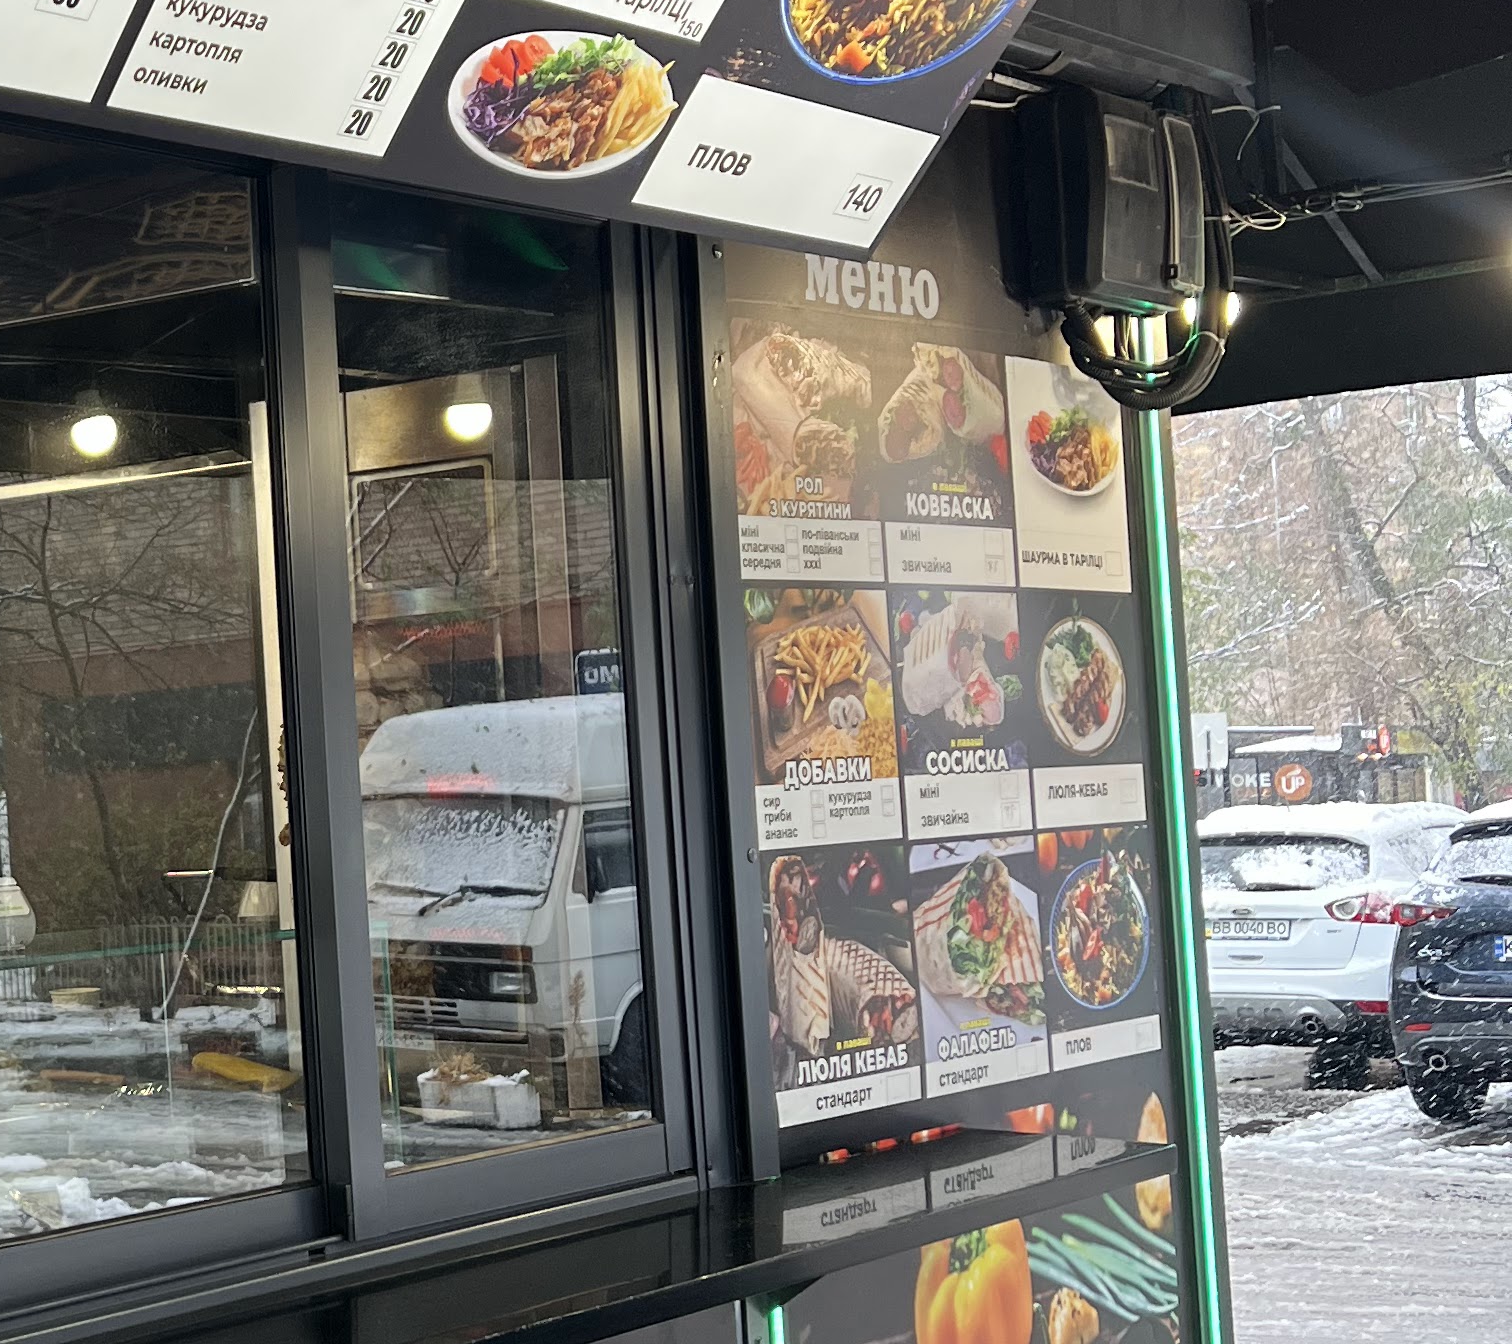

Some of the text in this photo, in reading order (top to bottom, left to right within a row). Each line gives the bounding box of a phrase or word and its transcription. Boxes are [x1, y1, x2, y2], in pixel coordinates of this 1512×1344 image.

[395, 9, 424, 38] 20
[679, 18, 704, 39] 150
[149, 30, 243, 65] картопля
[378, 42, 409, 71] 20
[132, 67, 209, 96] оливки
[362, 75, 391, 103] 20
[343, 109, 371, 137] 20
[688, 142, 752, 180] плов
[843, 183, 883, 214] 140
[796, 477, 824, 495] РОЛ
[781, 500, 852, 519] КУРЯТИНИ
[905, 492, 994, 520] КОВБАСКА
[1022, 550, 1060, 565] ШАУРМА
[784, 756, 872, 791] ДОБАВКИ
[925, 748, 1010, 775] СОСИСКА
[1048, 782, 1109, 800] ЛЮЛЯ-КЕБАБ
[764, 809, 792, 825] гриби
[937, 1026, 1017, 1062] ФАЛАФЕЛЬ
[1066, 1037, 1092, 1056] плов
[798, 1043, 909, 1085] ЛЮЛЯ КЕБАБ
[939, 1065, 990, 1088] стандарт
[816, 1087, 873, 1111] стандарт
